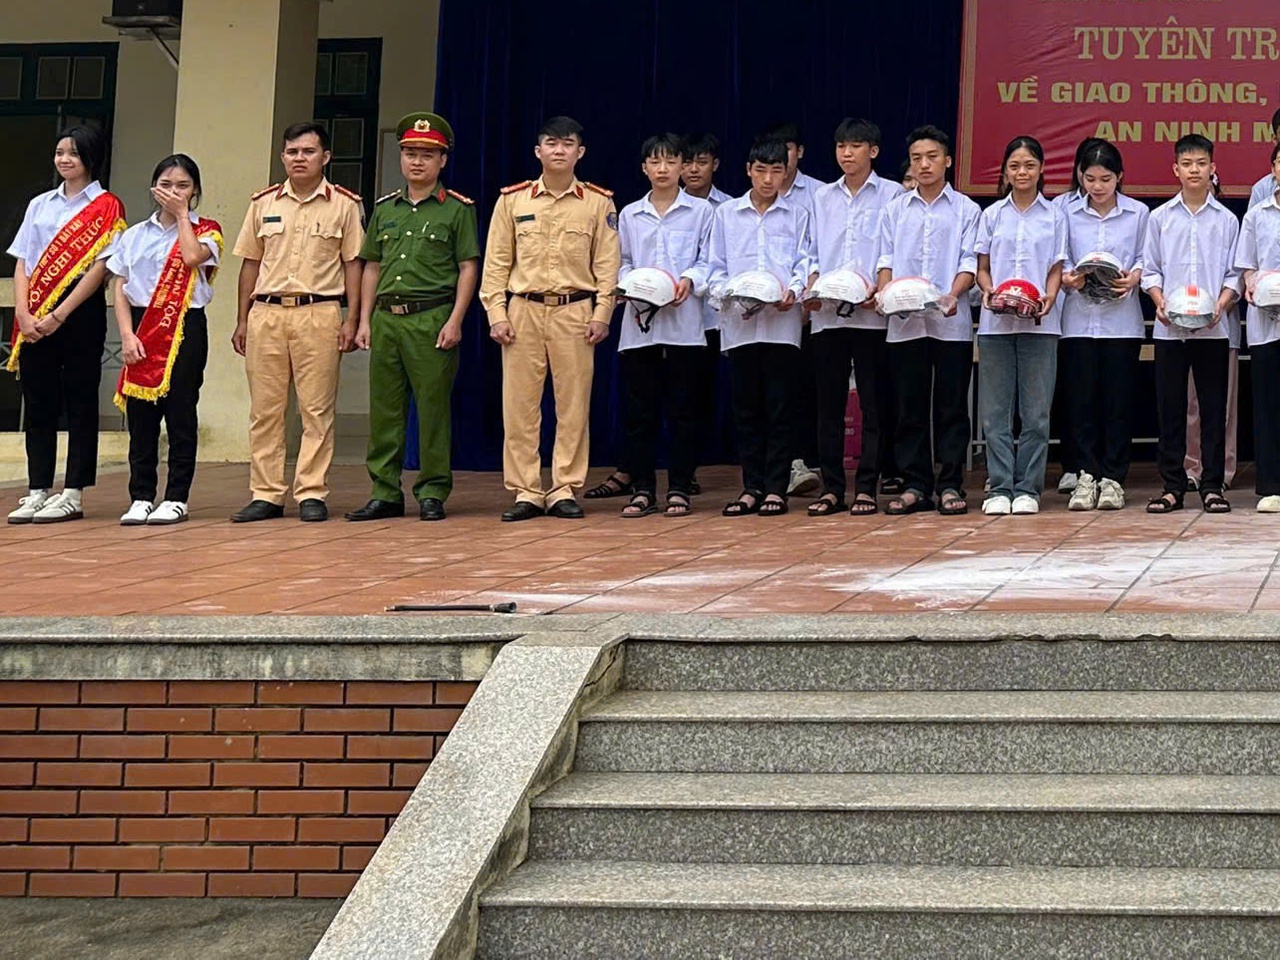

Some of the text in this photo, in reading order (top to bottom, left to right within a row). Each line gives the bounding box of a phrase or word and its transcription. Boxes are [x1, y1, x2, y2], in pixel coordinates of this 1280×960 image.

[1073, 16, 1216, 61] TUYÊN
[997, 75, 1038, 103] VỀ
[1050, 82, 1131, 104] GIAO
[1142, 78, 1268, 106] THÔNG,
[1094, 121, 1142, 141] AN
[1154, 121, 1240, 142] NINH
[40, 250, 73, 287] NGHI
